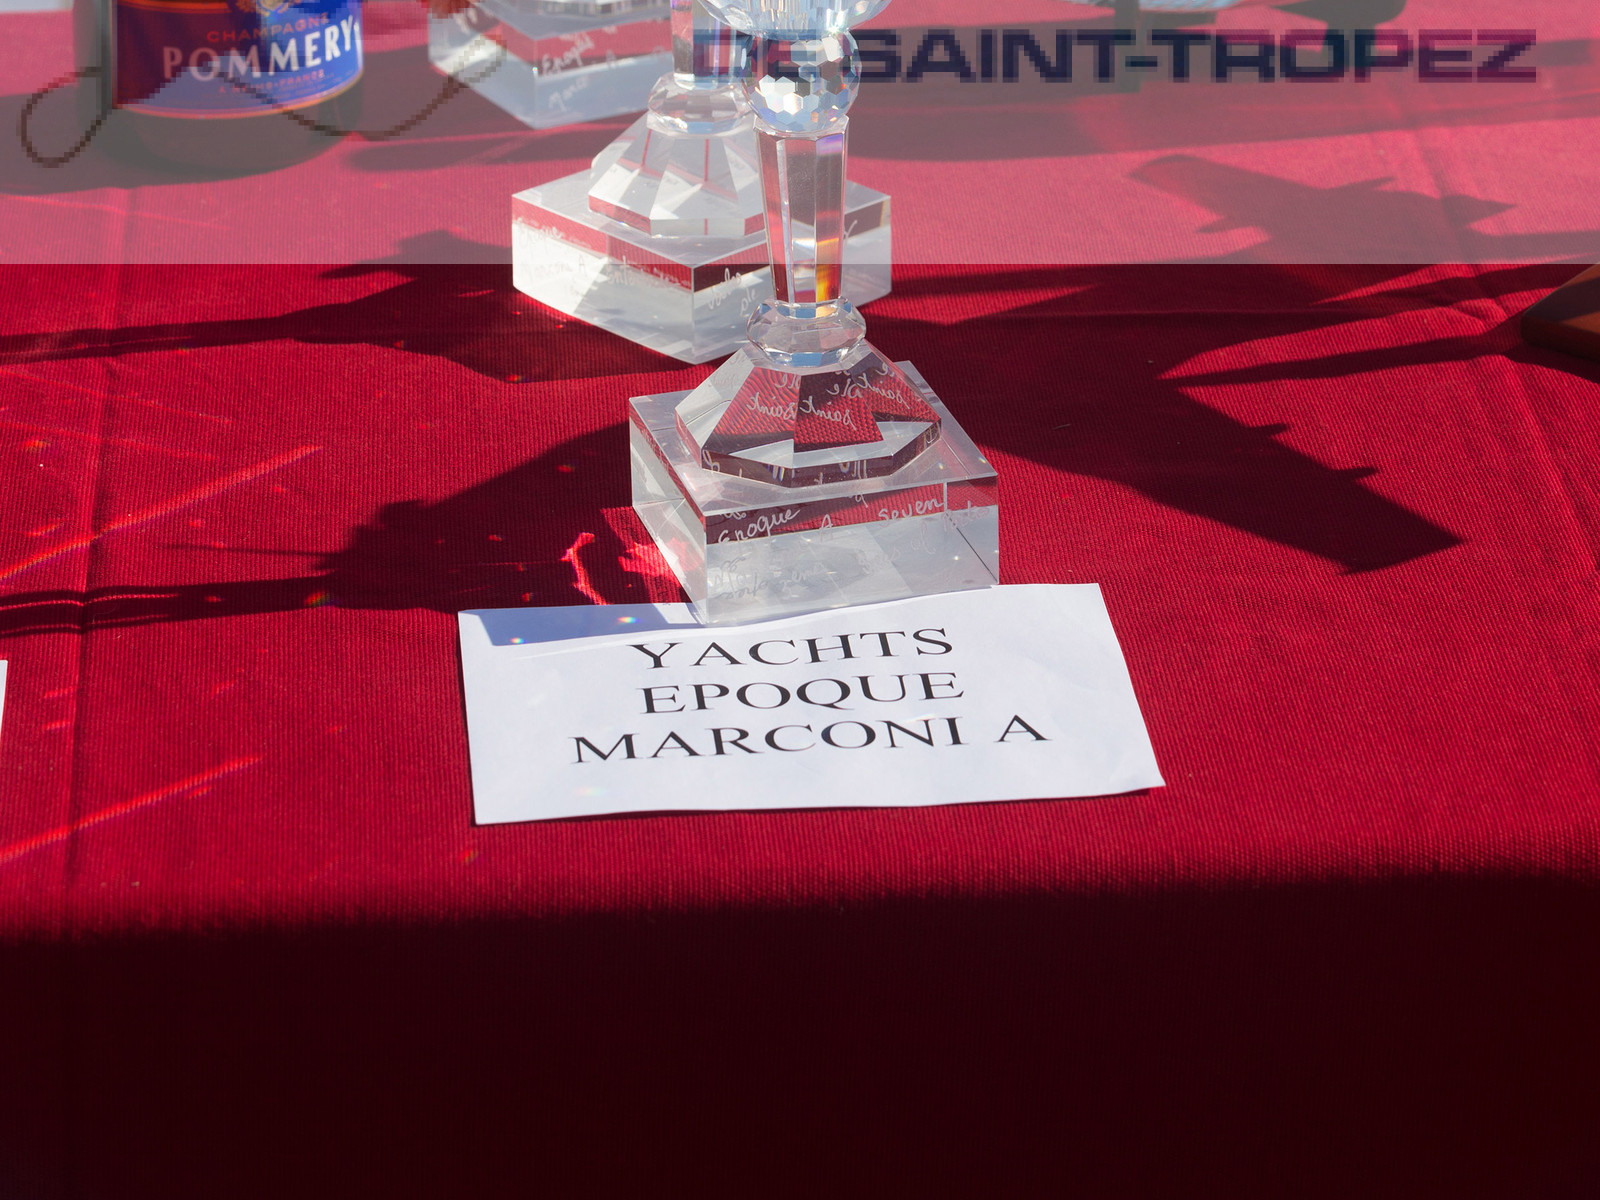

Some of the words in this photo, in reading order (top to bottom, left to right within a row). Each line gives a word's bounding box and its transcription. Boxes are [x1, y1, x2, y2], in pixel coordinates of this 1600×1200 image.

[162, 15, 354, 82] POMMERY
[206, 12, 329, 43] CHAMPAGNE
[628, 628, 953, 669] YACHTS
[635, 672, 965, 714] EPOQUE
[570, 717, 970, 764] MARCONI
[994, 714, 1053, 743] A
